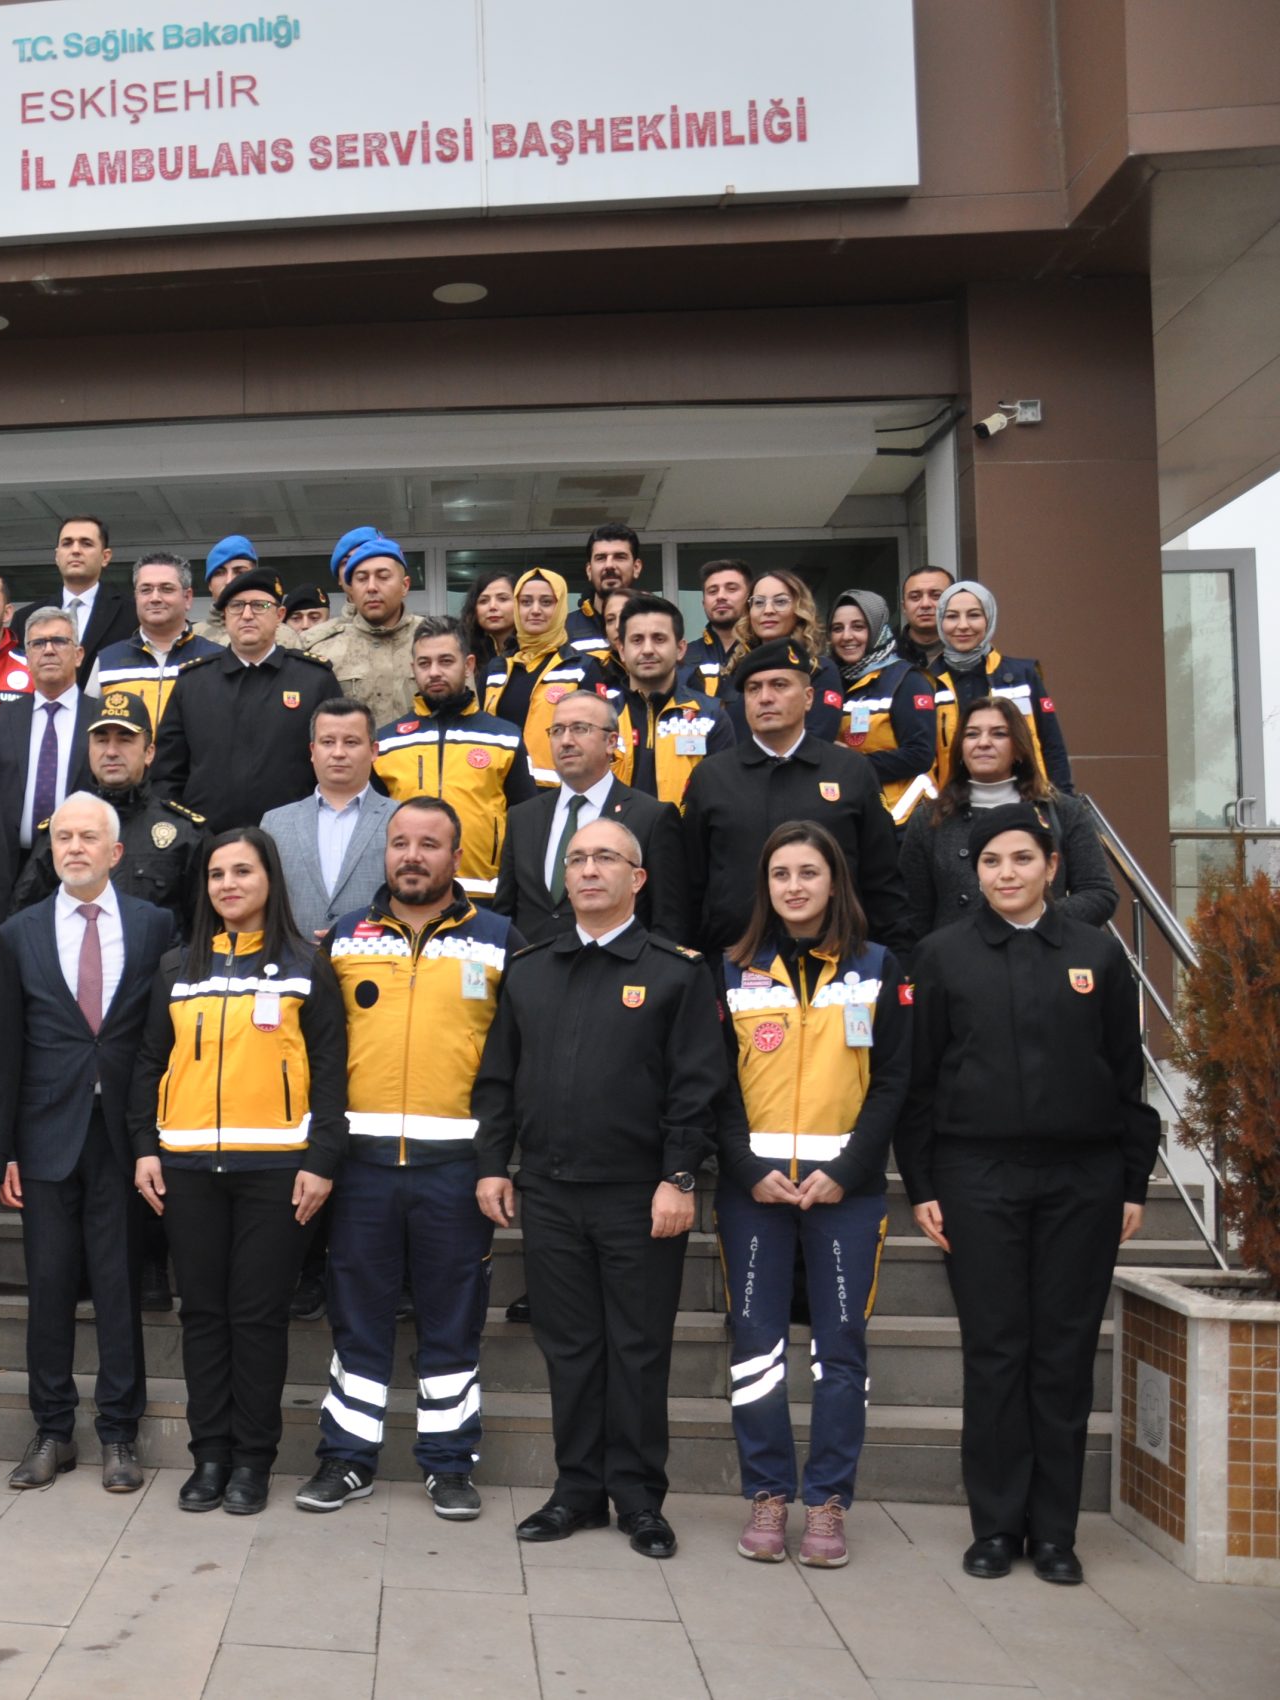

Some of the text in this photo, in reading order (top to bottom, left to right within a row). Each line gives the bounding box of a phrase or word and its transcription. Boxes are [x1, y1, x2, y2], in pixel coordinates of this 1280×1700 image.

[13, 15, 301, 62] T.C. Sağlık Bakanlığı
[20, 71, 260, 124] ESKİŞEHİR
[21, 97, 808, 190] İL AMBULANS SERVİSİ BAŞHEKİMLİĞİ
